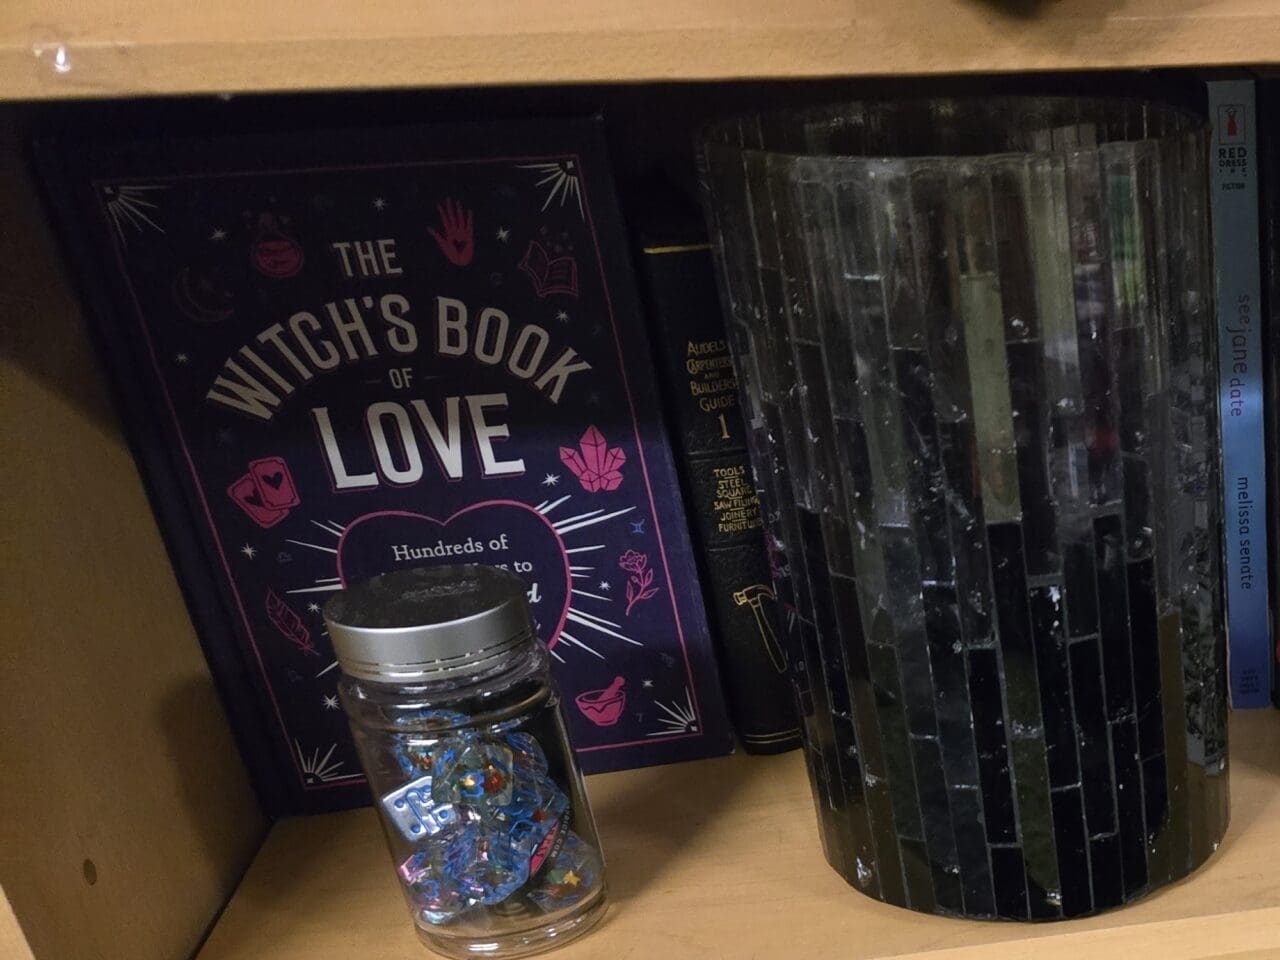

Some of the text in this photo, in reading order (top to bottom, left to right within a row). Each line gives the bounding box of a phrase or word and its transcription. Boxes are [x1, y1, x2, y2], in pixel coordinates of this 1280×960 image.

[1218, 147, 1248, 159] RED
[331, 238, 404, 280] THE
[206, 292, 594, 423] WITCH'S BOOK
[1226, 294, 1250, 418] see jane date
[388, 366, 414, 391] OF
[311, 392, 527, 492] LOVE
[712, 466, 746, 478] TOOLS
[391, 533, 510, 562] Hundreds of
[1237, 476, 1254, 590] melissa senate
[513, 559, 534, 574] to
